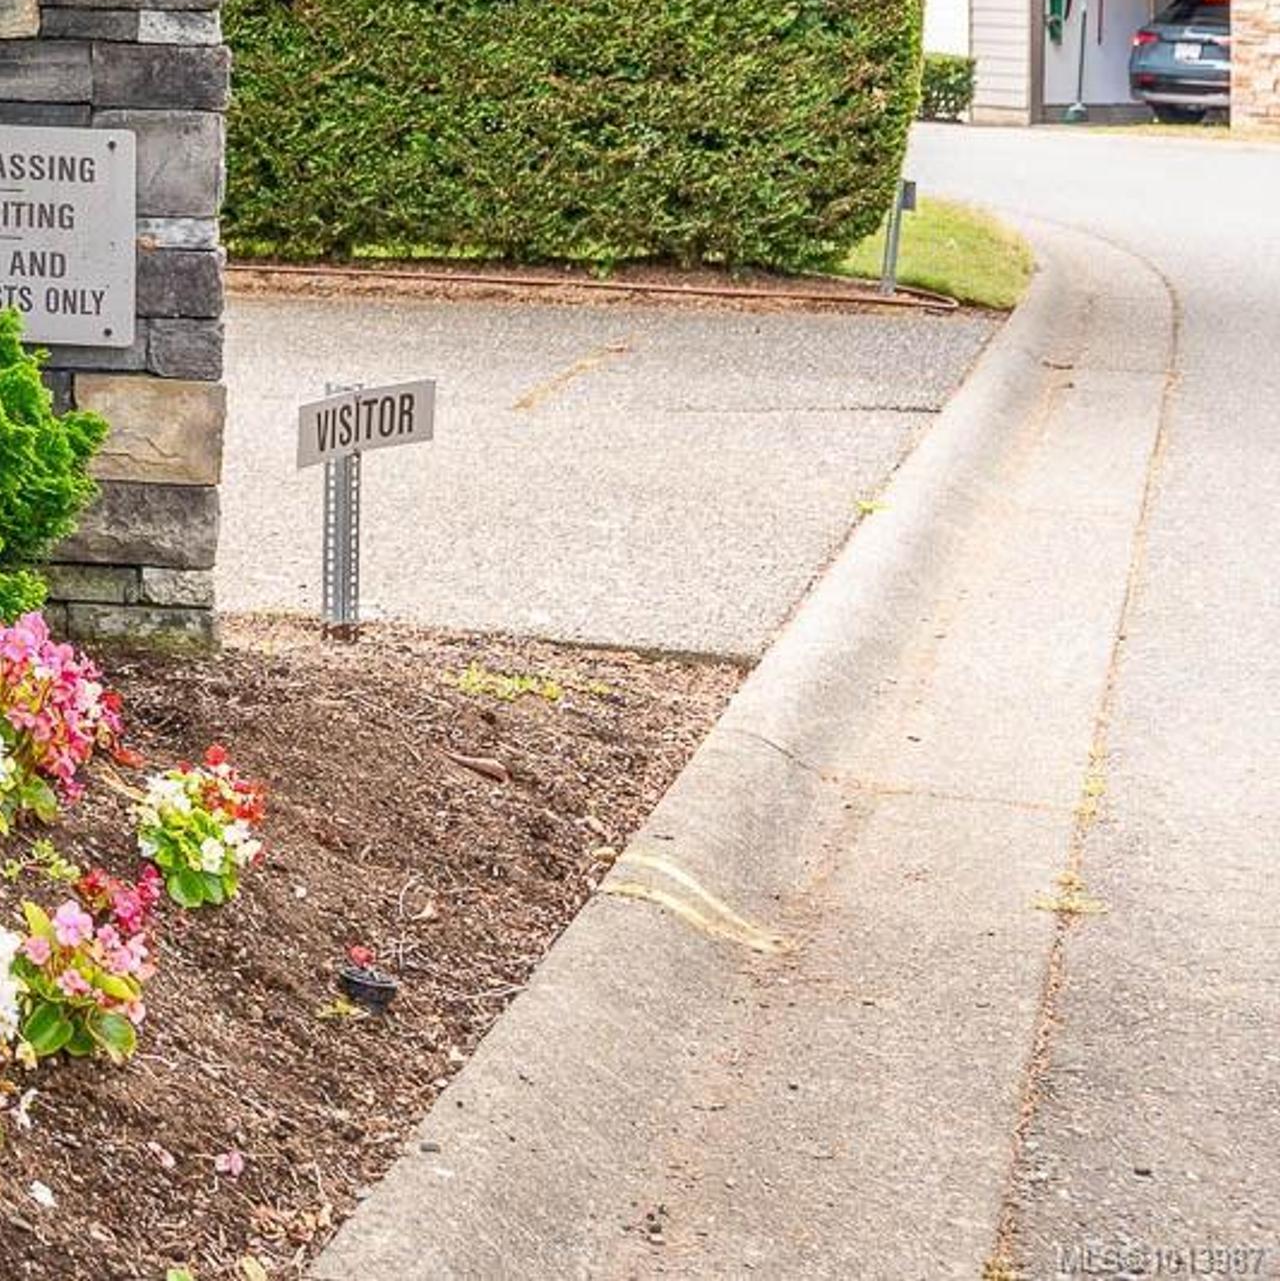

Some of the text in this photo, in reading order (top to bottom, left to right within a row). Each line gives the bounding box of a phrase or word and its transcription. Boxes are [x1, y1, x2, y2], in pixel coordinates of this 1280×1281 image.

[9, 250, 67, 279] AND
[45, 287, 106, 316] ONLY
[316, 392, 415, 452] VISITOR
